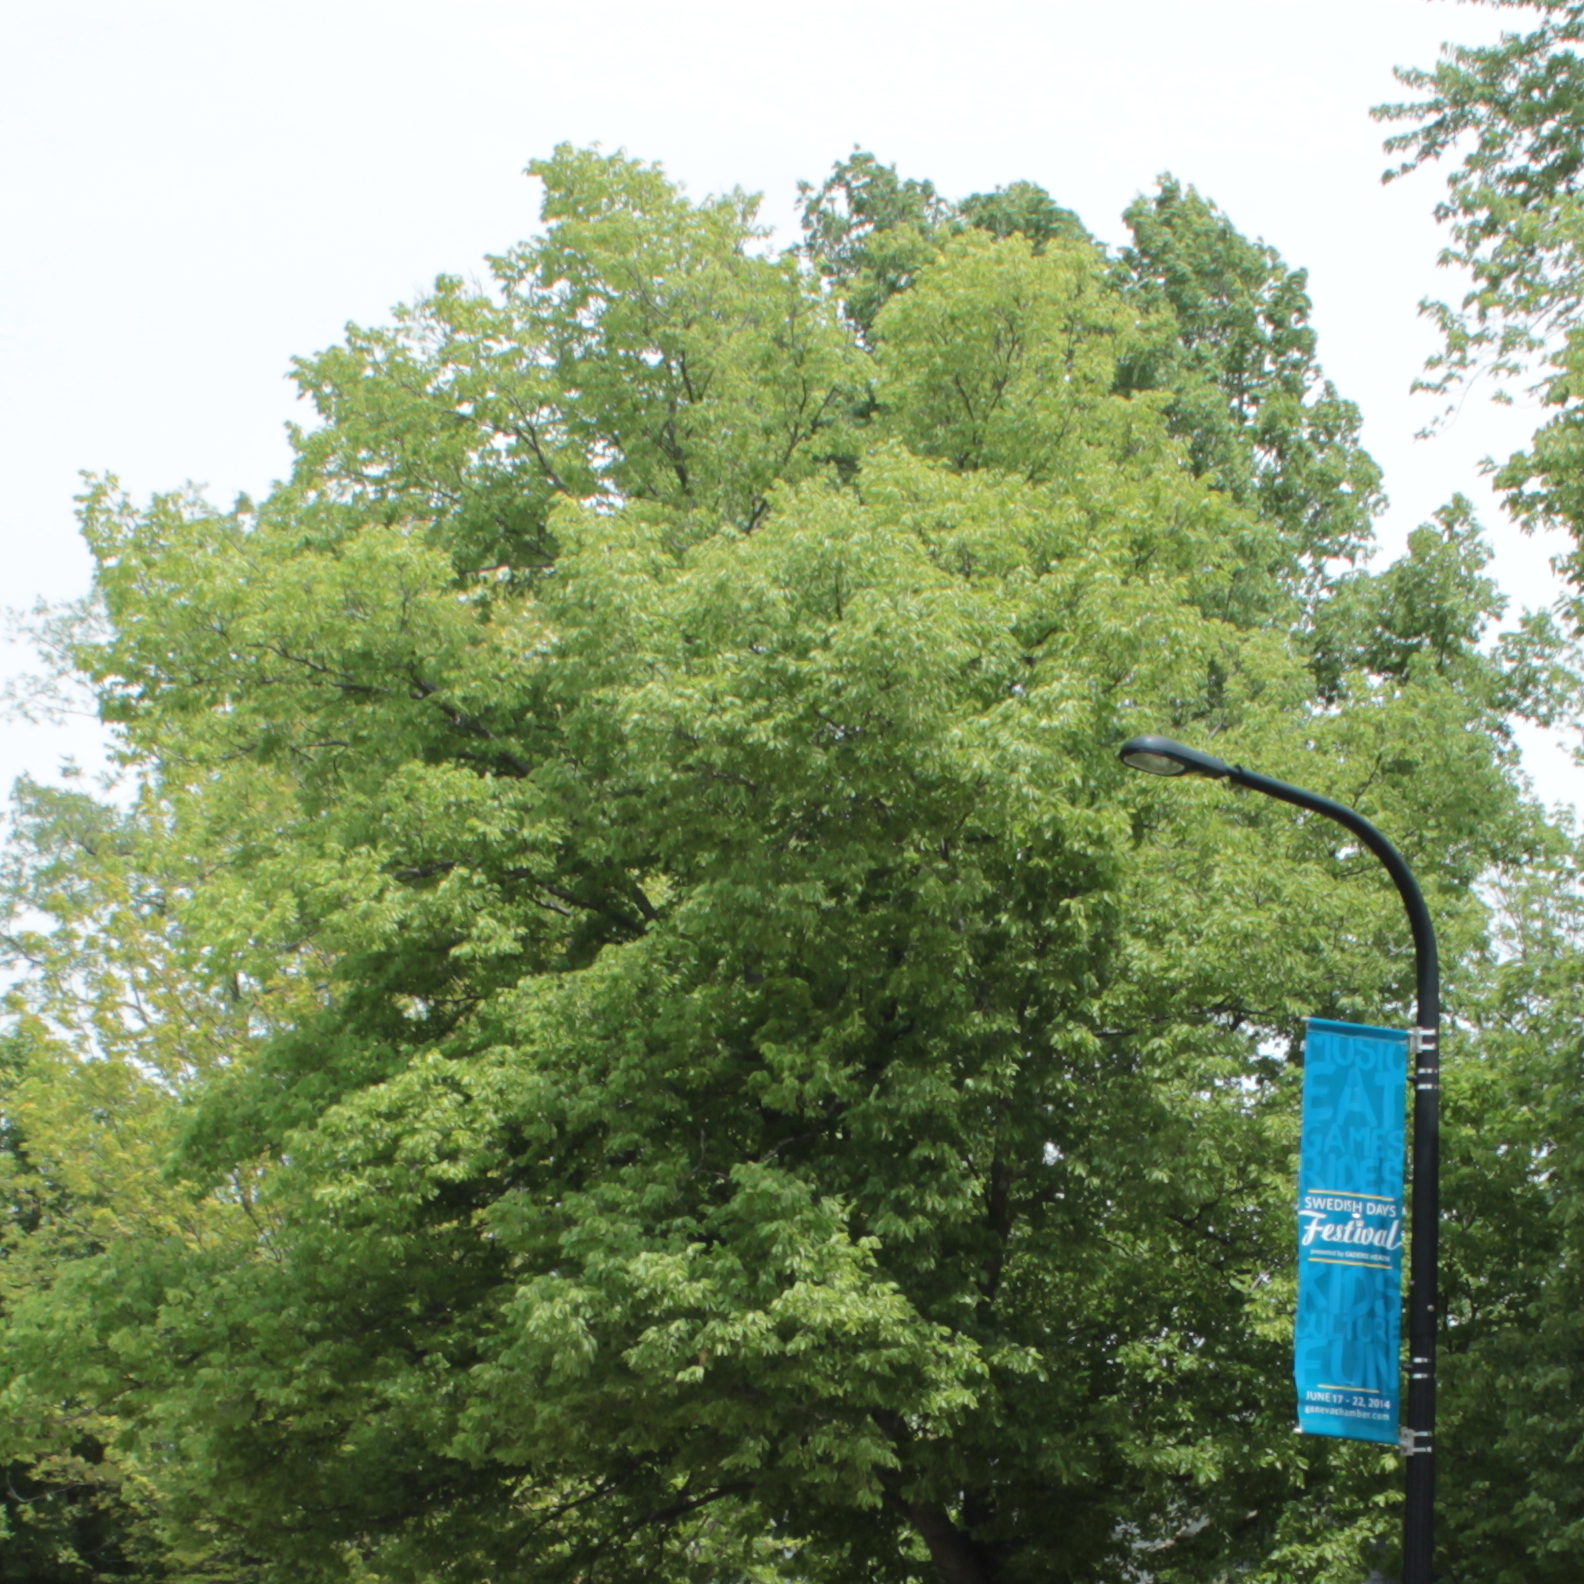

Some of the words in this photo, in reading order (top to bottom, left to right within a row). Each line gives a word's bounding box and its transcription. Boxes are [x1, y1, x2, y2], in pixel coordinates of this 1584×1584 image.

[1304, 1062, 1407, 1130] EAT
[1303, 1124, 1404, 1160] GAMES
[1301, 1152, 1403, 1198] RIDES
[1305, 1197, 1363, 1213] SWEDISH
[1366, 1202, 1397, 1217] DAYS
[1298, 1210, 1402, 1250] Festival
[1295, 1338, 1400, 1389] FUN
[1305, 1405, 1390, 1421] genevachamber.com
[1306, 1391, 1330, 1402] JUNE
[1333, 1395, 1343, 1404] 17
[1368, 1398, 1391, 1409] 2014
